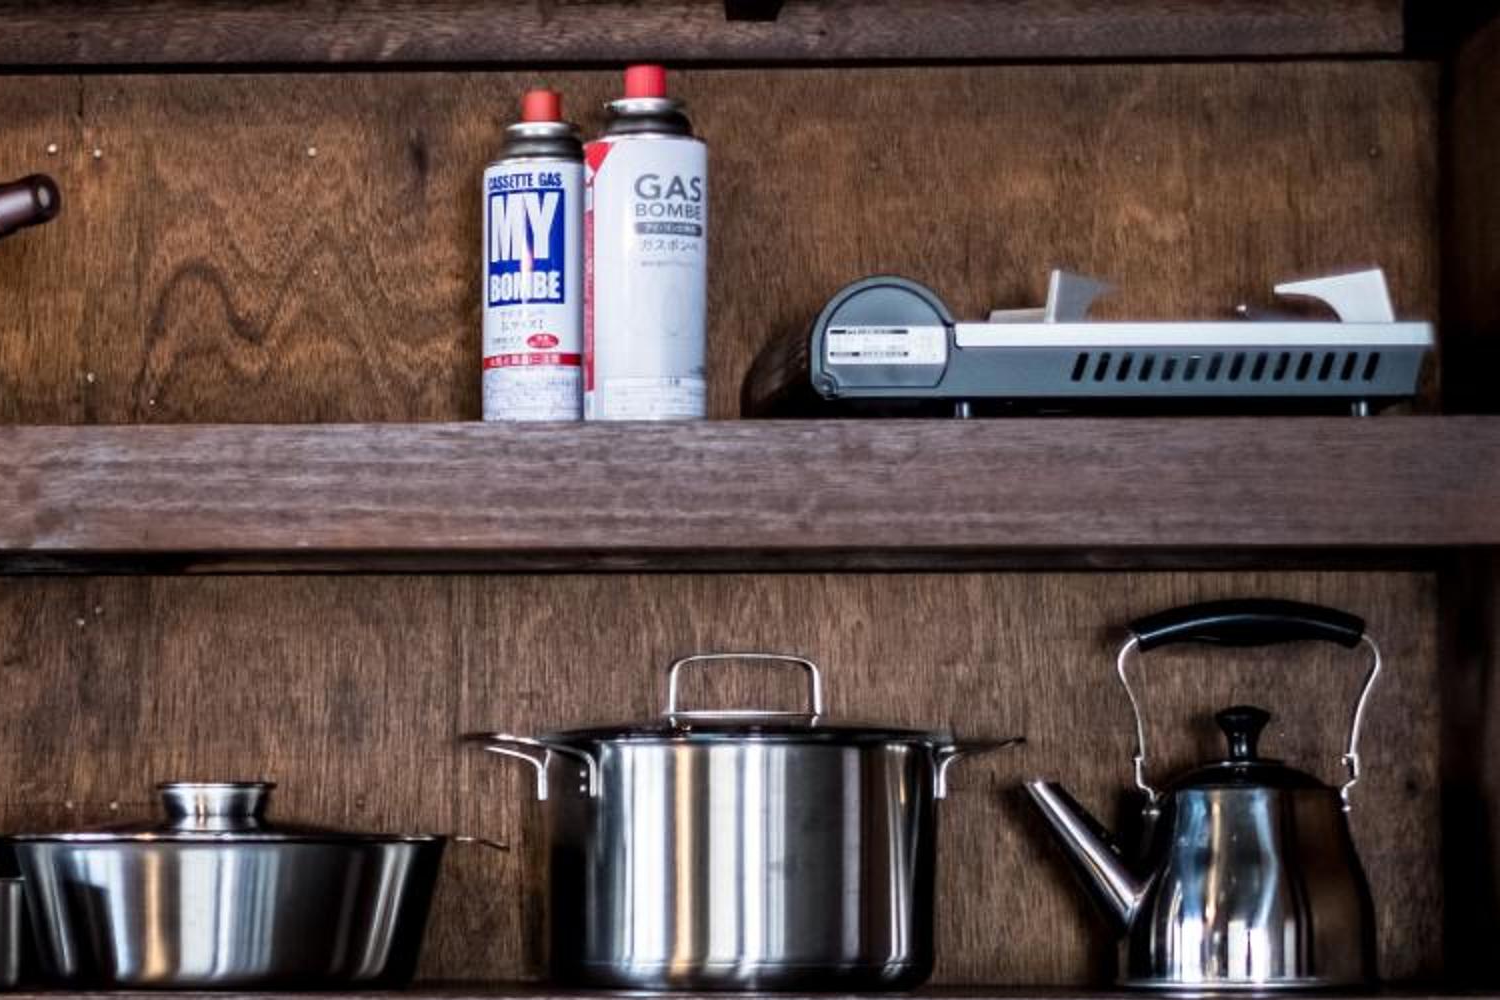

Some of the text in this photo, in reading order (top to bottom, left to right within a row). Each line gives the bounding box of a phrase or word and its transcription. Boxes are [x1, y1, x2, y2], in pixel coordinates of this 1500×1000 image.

[488, 172, 562, 191] CASSETTE GAS
[634, 173, 702, 202] GAS
[635, 202, 702, 220] BOMBE
[491, 190, 560, 262] MY
[490, 270, 560, 302] BOMBE
